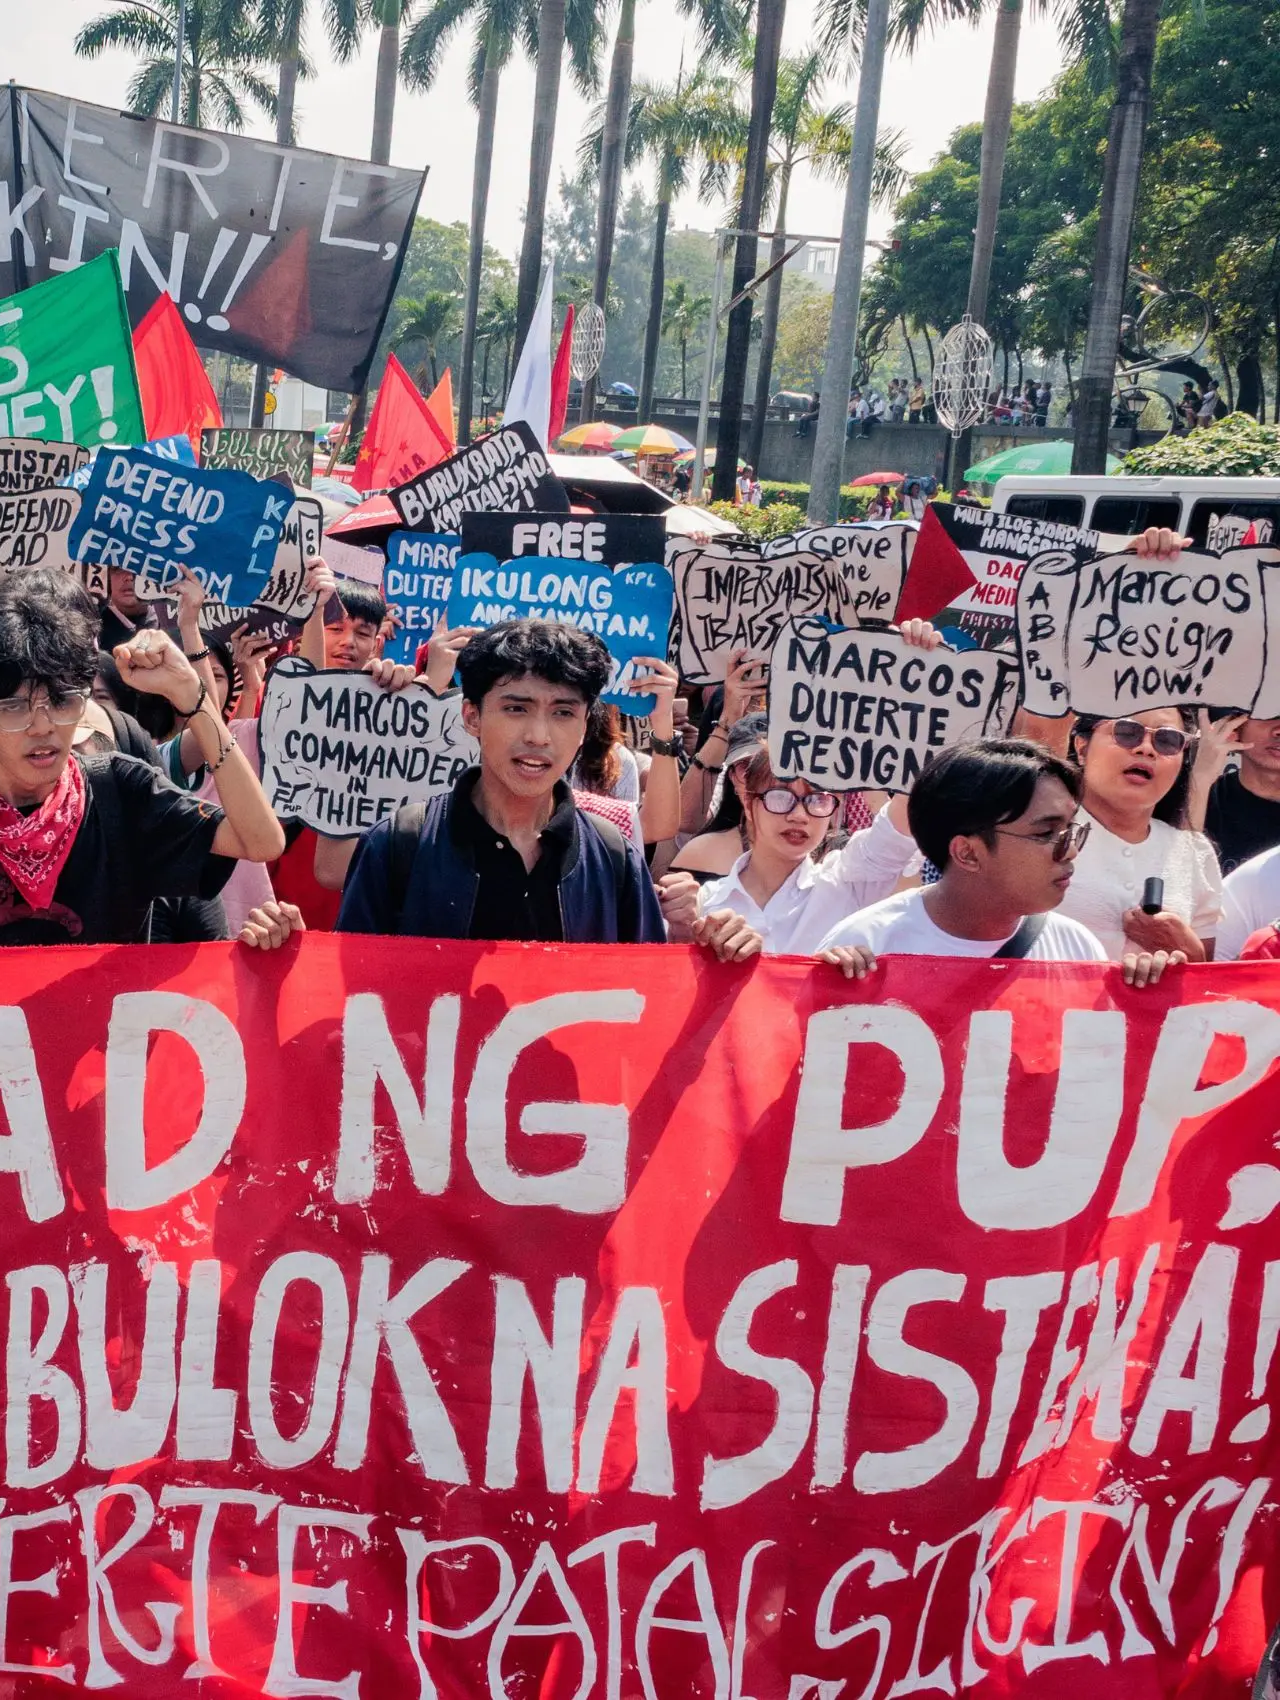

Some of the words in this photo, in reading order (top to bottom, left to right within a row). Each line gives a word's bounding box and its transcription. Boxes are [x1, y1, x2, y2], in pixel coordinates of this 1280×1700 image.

[105, 454, 225, 525] DEFEND
[397, 430, 526, 526] BURUKRATA
[94, 494, 198, 555] PRESS
[512, 521, 607, 562] FREE
[1033, 520, 1100, 549] JORDAN
[76, 527, 233, 604] FREEDOM
[460, 567, 613, 610] IKULONG
[624, 571, 657, 588] KPL
[1080, 563, 1251, 614] Marcos
[470, 601, 518, 625] ANG
[1081, 613, 1234, 671] Resign
[786, 636, 985, 709] MARCOS
[300, 683, 430, 739] MARCOS
[789, 681, 950, 746] DUTERTE
[284, 729, 469, 788] COMMANDER
[346, 774, 368, 796] IN
[779, 729, 935, 787] RESIGN
[330, 988, 647, 1214] NG
[4, 1249, 475, 1493] BULOK
[484, 1272, 676, 1499] NA
